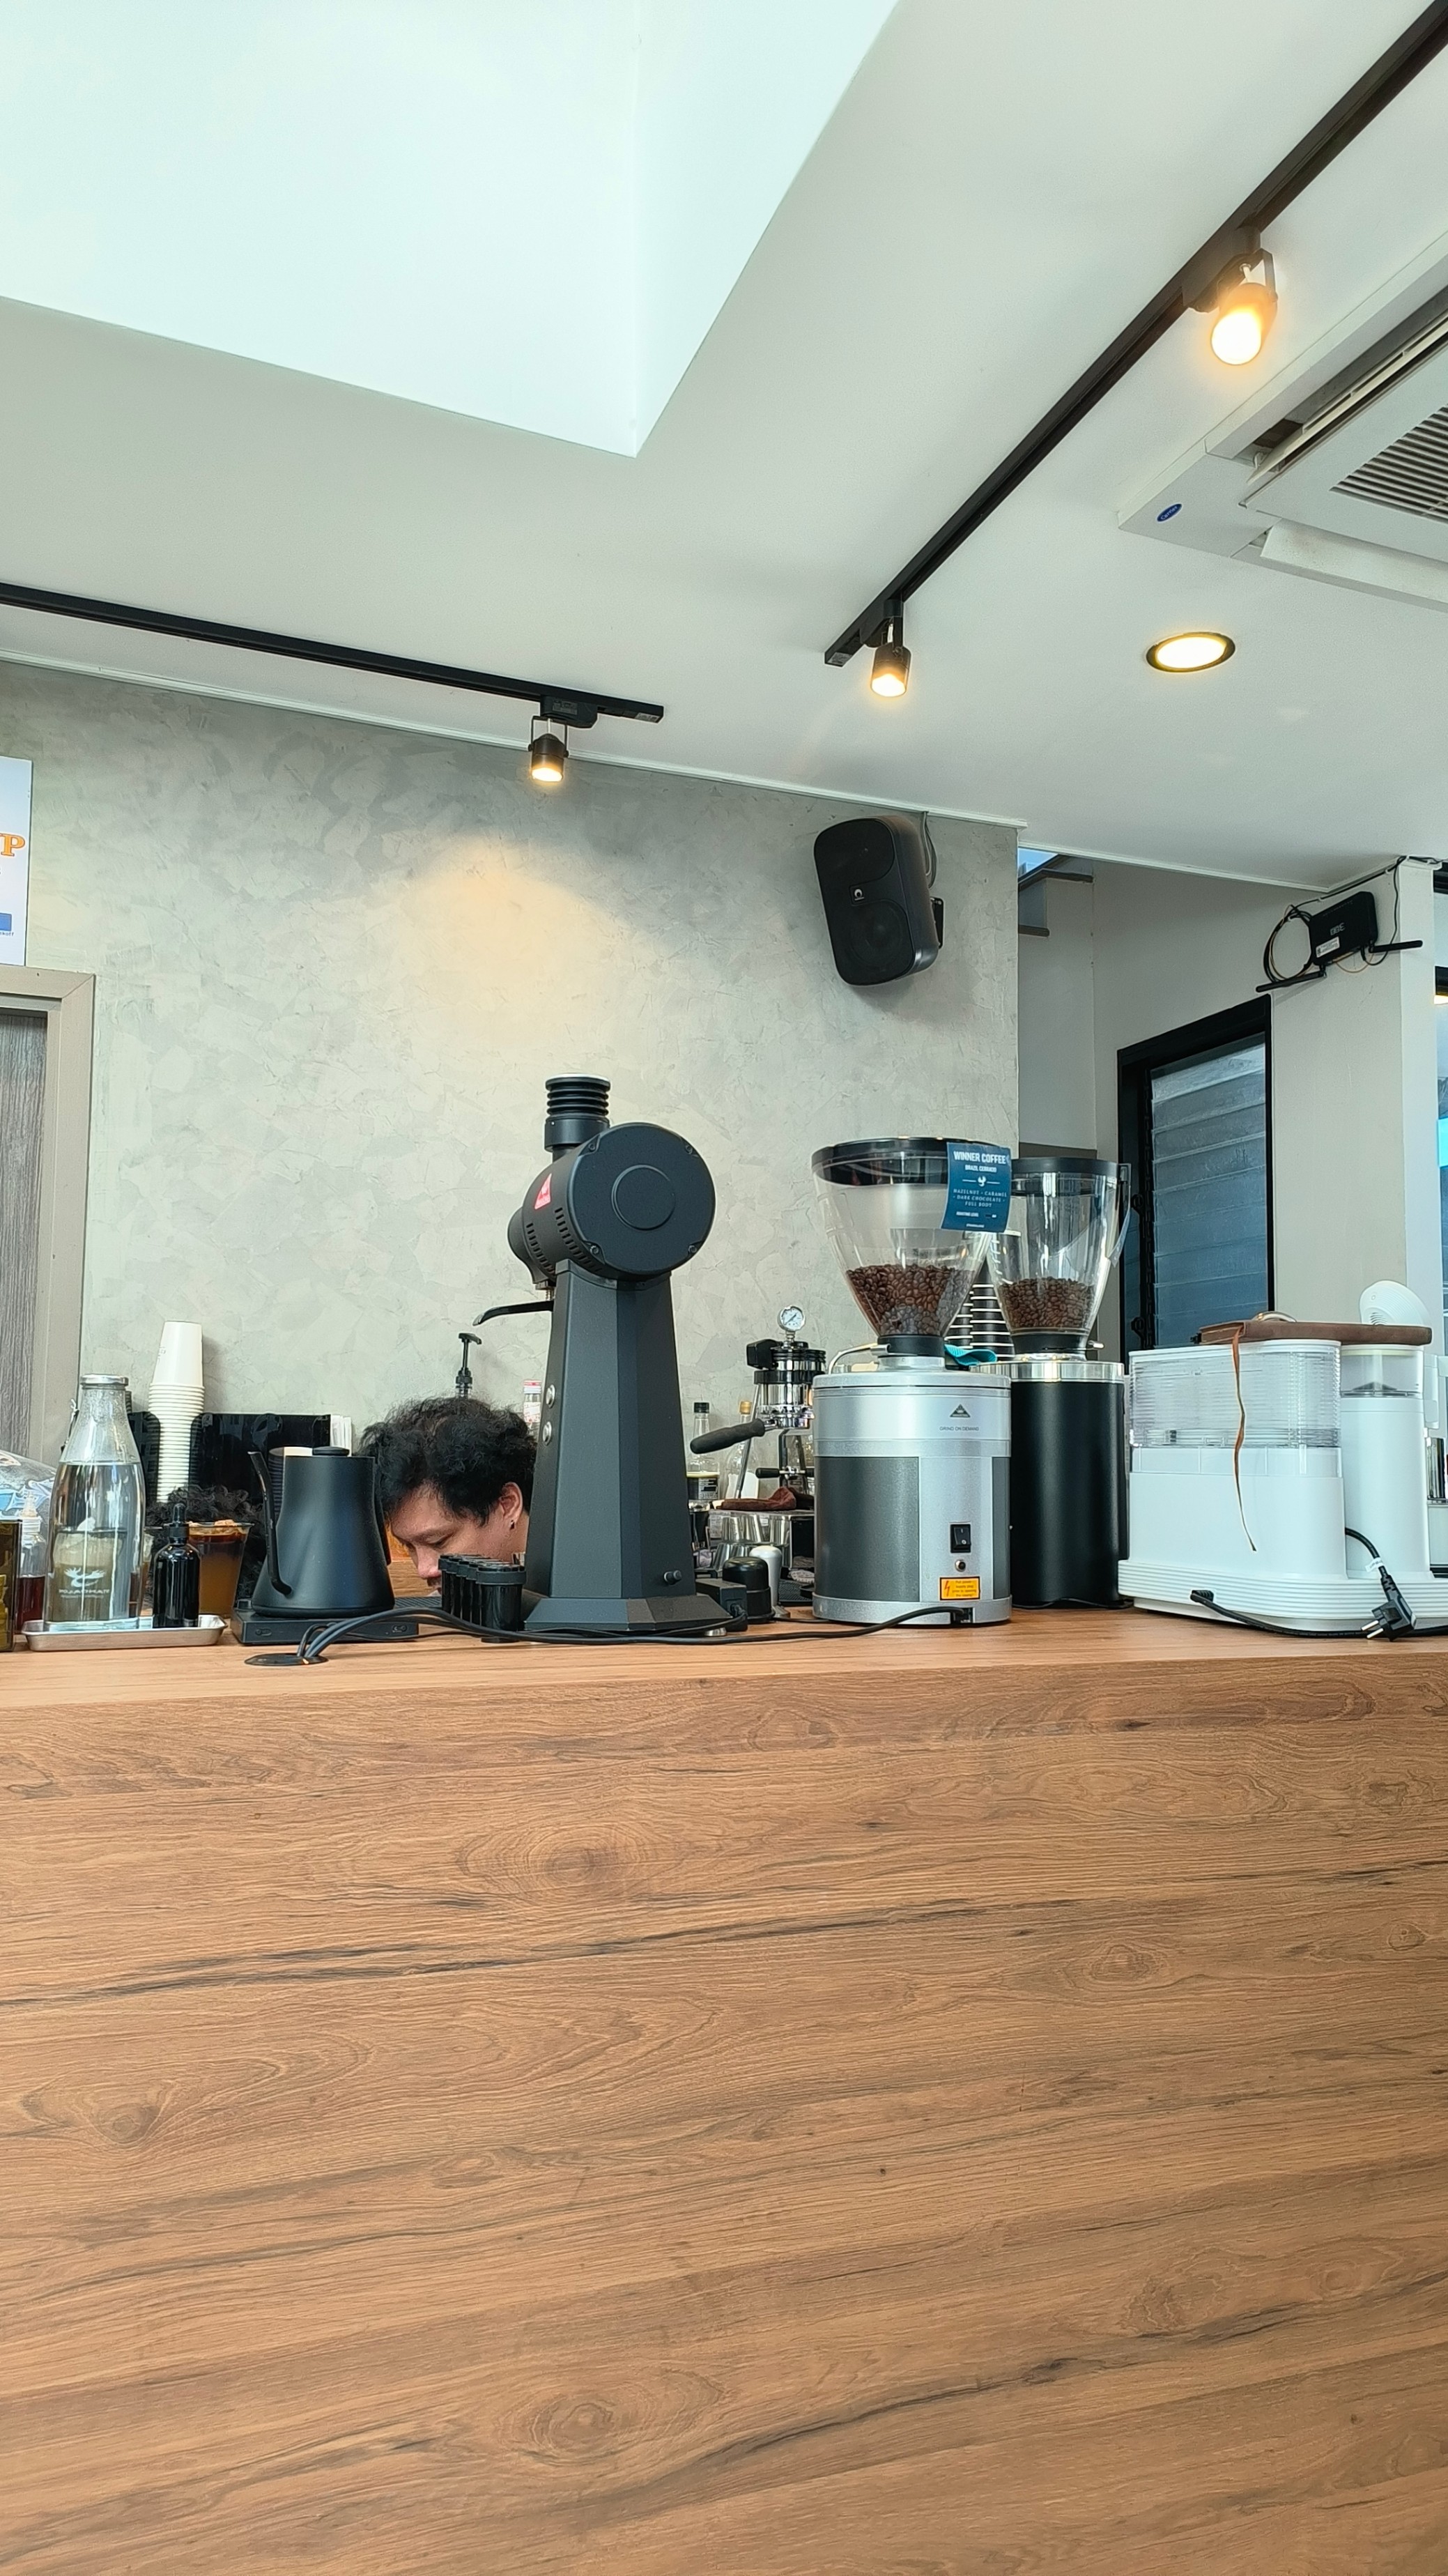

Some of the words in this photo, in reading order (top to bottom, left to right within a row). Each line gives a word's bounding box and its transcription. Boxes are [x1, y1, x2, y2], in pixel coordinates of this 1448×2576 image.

[1160, 505, 1178, 520] Carrier
[0, 833, 25, 857] P
[953, 1151, 980, 1163] WINNER
[981, 1153, 1006, 1165] COFFEE
